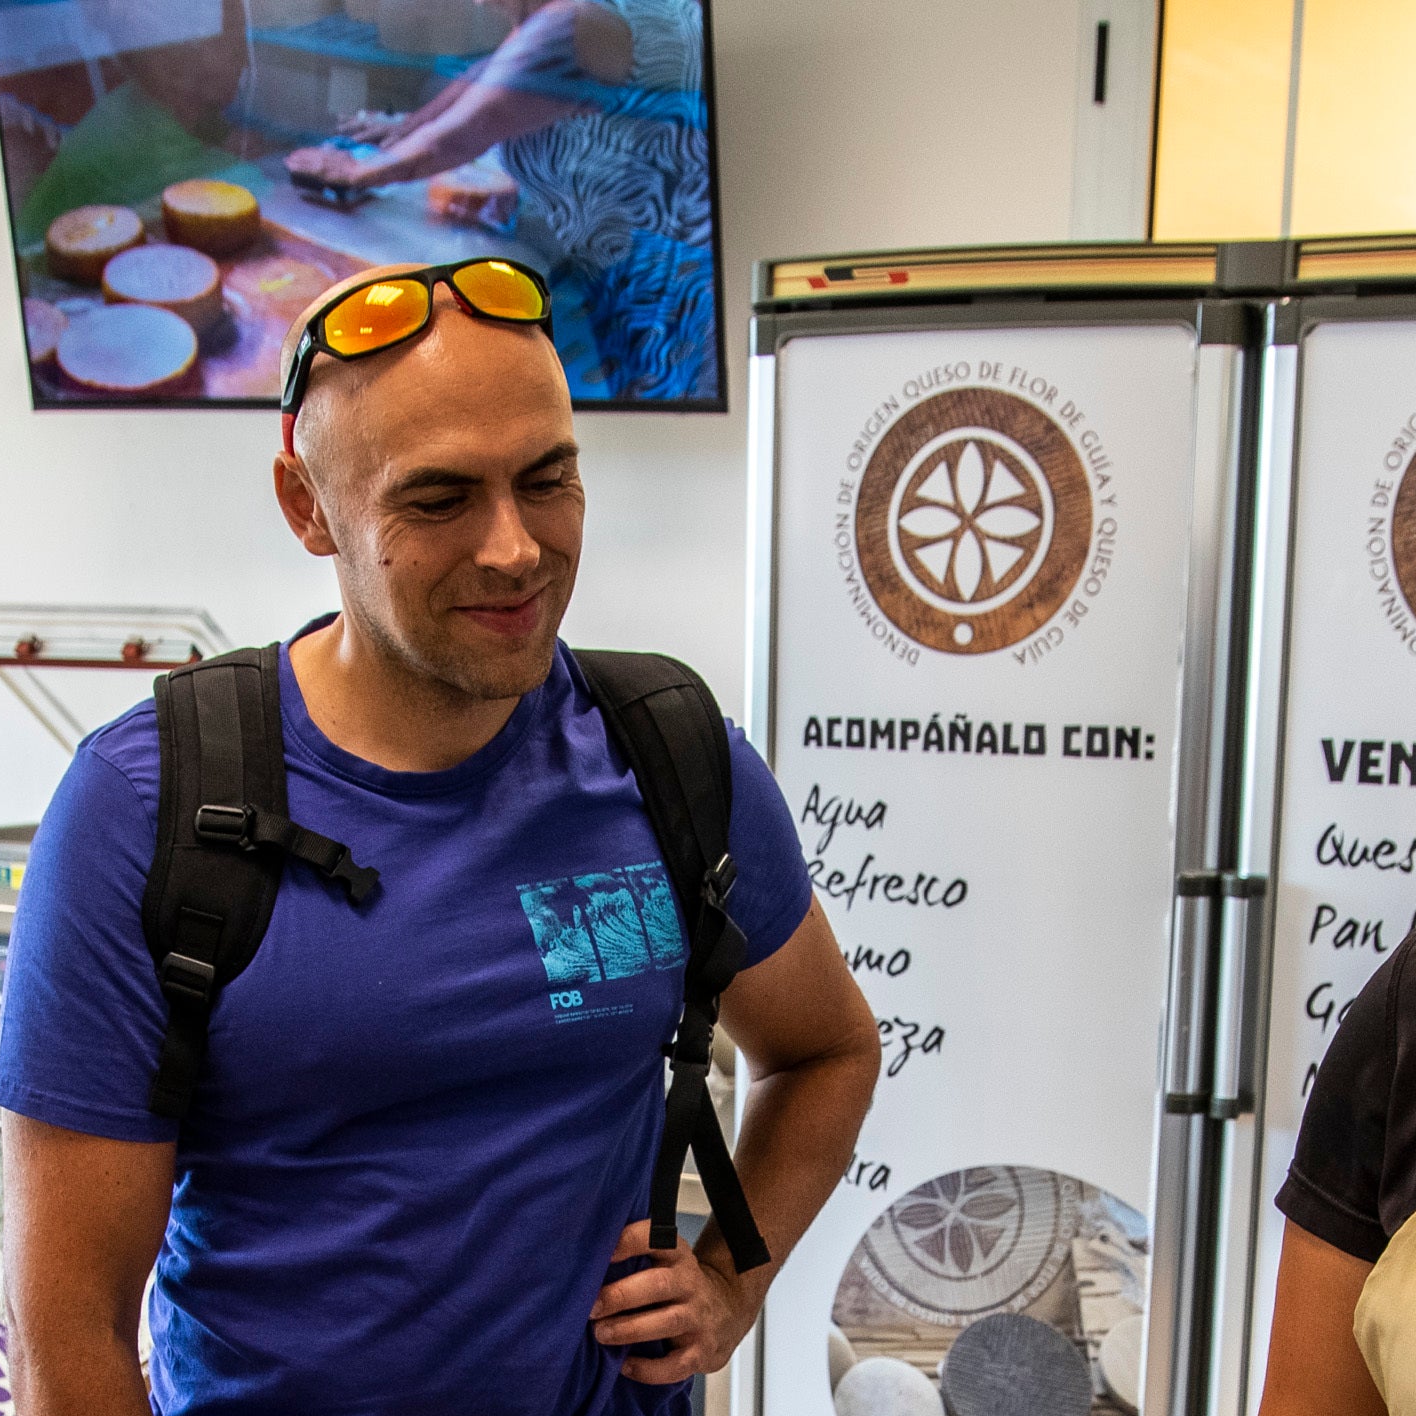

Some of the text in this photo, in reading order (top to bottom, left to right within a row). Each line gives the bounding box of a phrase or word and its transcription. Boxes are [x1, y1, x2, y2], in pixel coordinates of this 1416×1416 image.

[903, 361, 971, 399] QUESO
[978, 361, 1003, 380] DE
[1008, 366, 1058, 404] FLOR
[1059, 400, 1085, 427] DE
[846, 394, 900, 472] ORIGEN
[837, 478, 854, 505] DE
[1100, 493, 1118, 507] Y
[1371, 478, 1394, 508] DE
[1084, 517, 1118, 598] QUESO
[834, 512, 920, 666] DENOMINACIÓN
[1063, 599, 1089, 628] DE
[803, 713, 1156, 760] ACOMPÁÑALO CON:
[801, 784, 888, 856] Agua
[1309, 904, 1388, 953] Pan
[549, 990, 583, 1010] FOB
